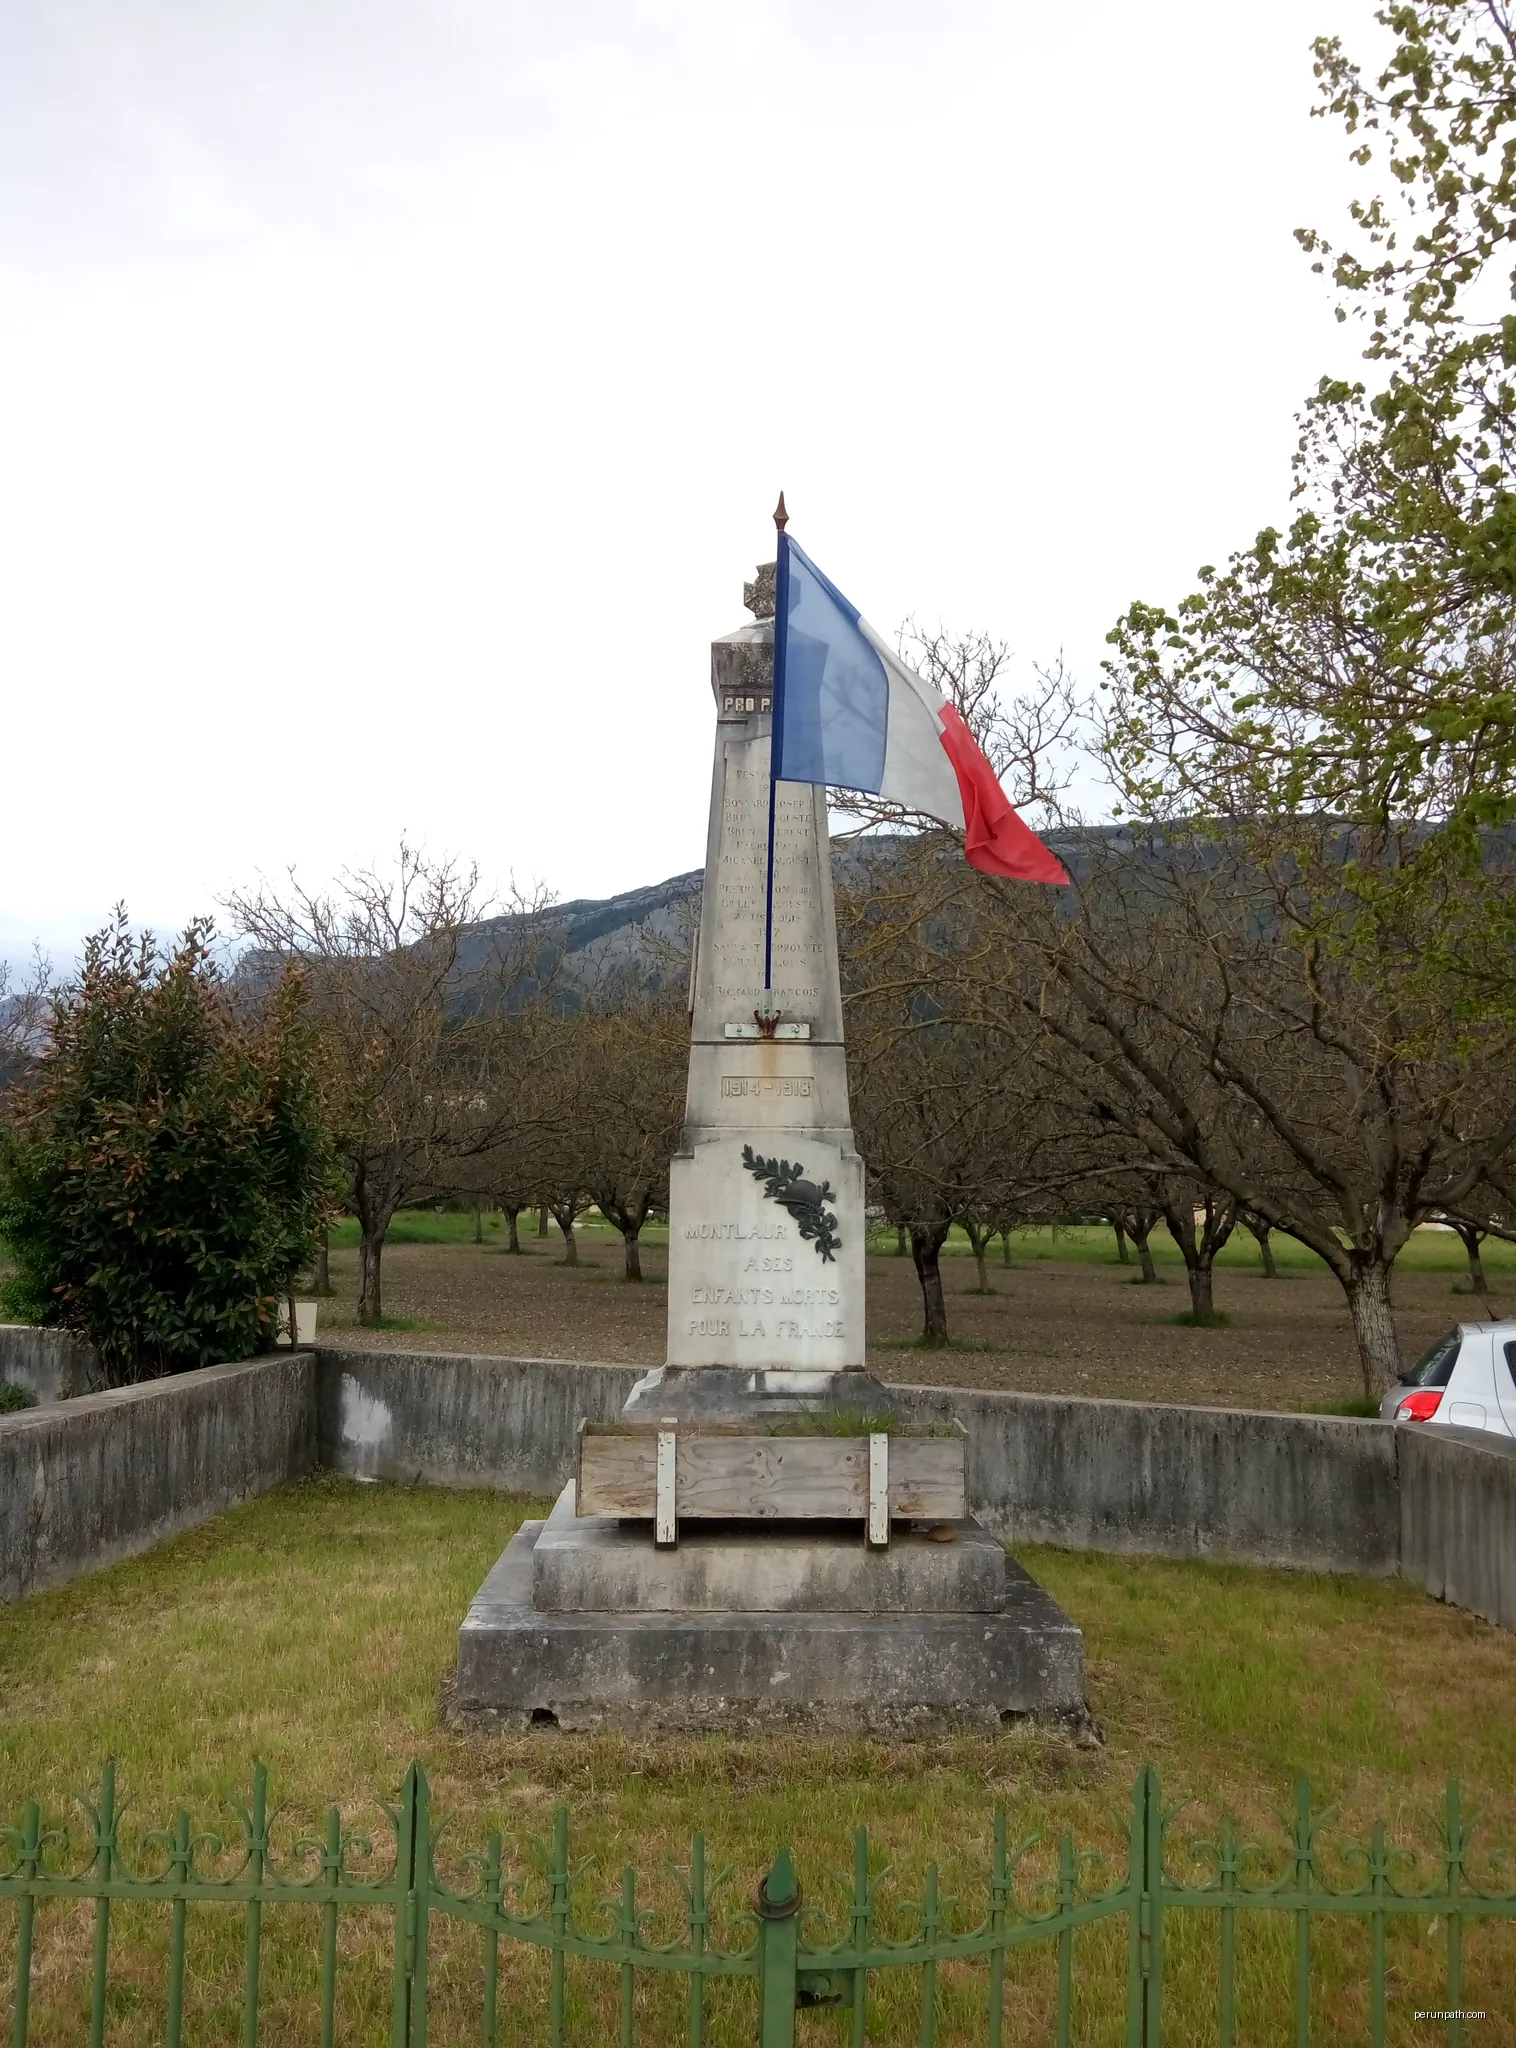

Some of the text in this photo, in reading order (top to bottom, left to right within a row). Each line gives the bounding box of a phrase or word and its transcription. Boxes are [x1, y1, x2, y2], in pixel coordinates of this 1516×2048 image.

[724, 697, 755, 713] PRO
[685, 1223, 787, 1240] MONTLAUR
[762, 1257, 793, 1272] SES
[691, 1287, 841, 1305] ENFANTS MORTS
[688, 1319, 845, 1338] POUR LA FRANCE
